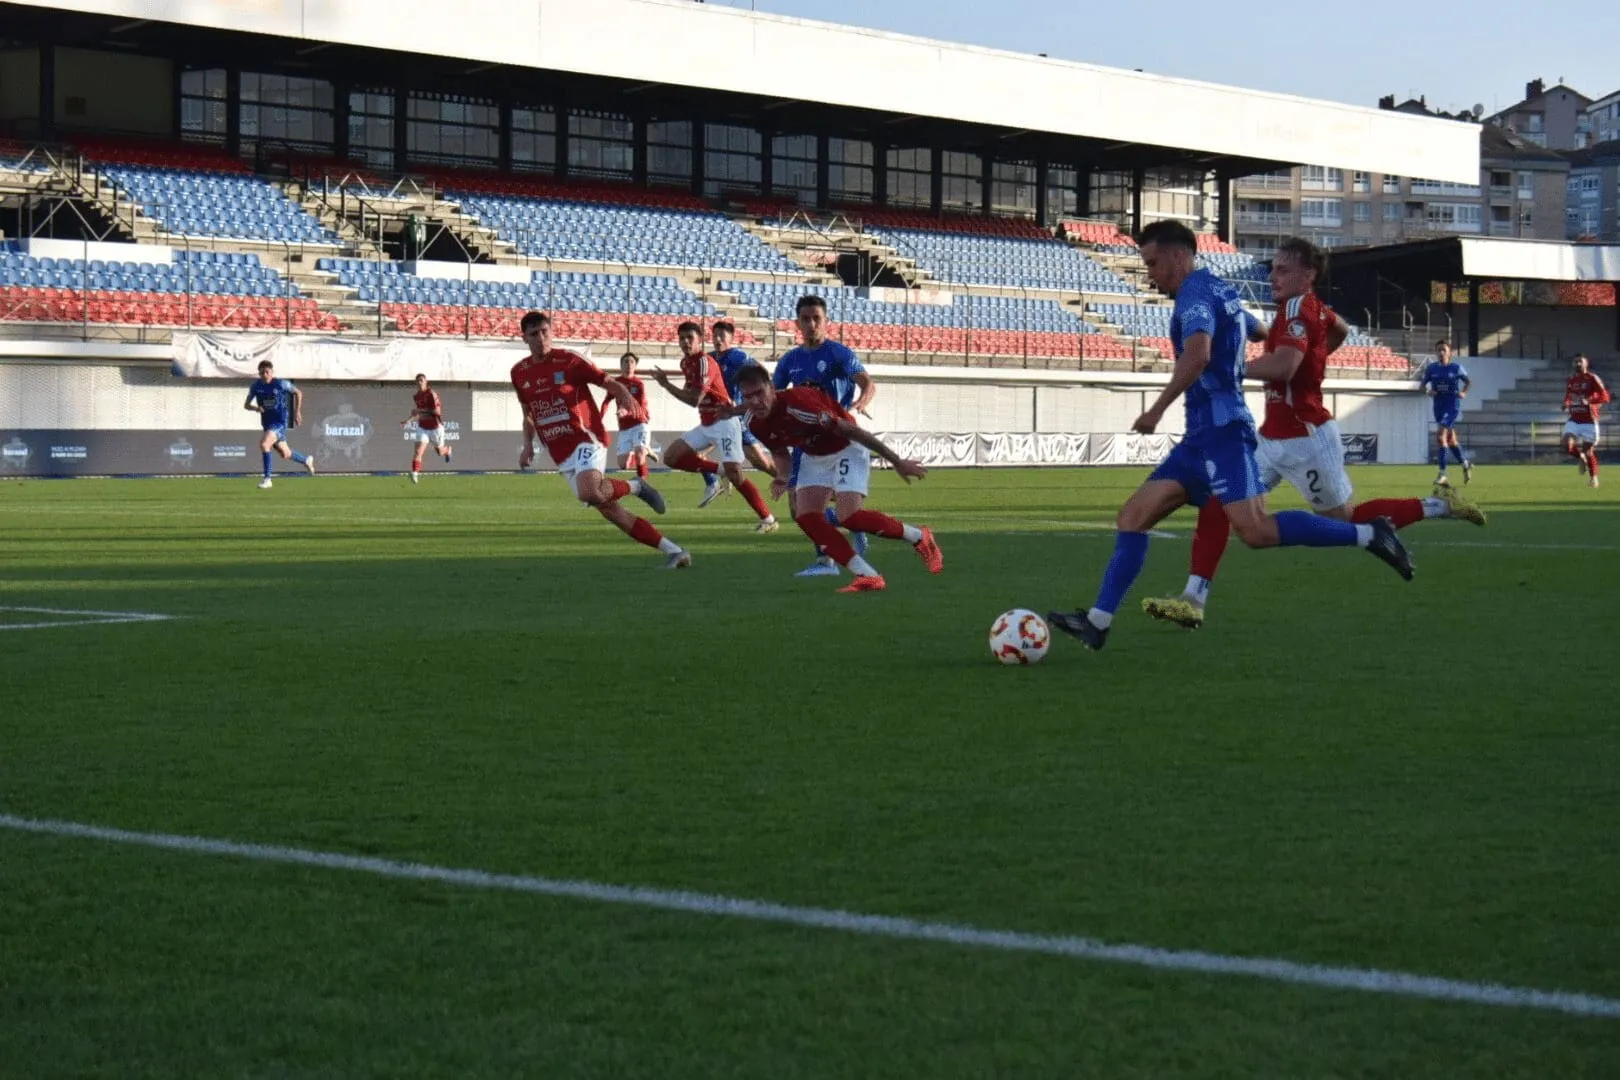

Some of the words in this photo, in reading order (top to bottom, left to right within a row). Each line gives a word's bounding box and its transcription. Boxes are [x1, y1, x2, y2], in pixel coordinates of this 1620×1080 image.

[325, 424, 364, 436] barazal
[722, 438, 732, 451] 12
[997, 434, 1088, 463] ABANCA
[578, 448, 592, 461] 15
[839, 459, 850, 475] 5
[1306, 470, 1322, 493] 2
